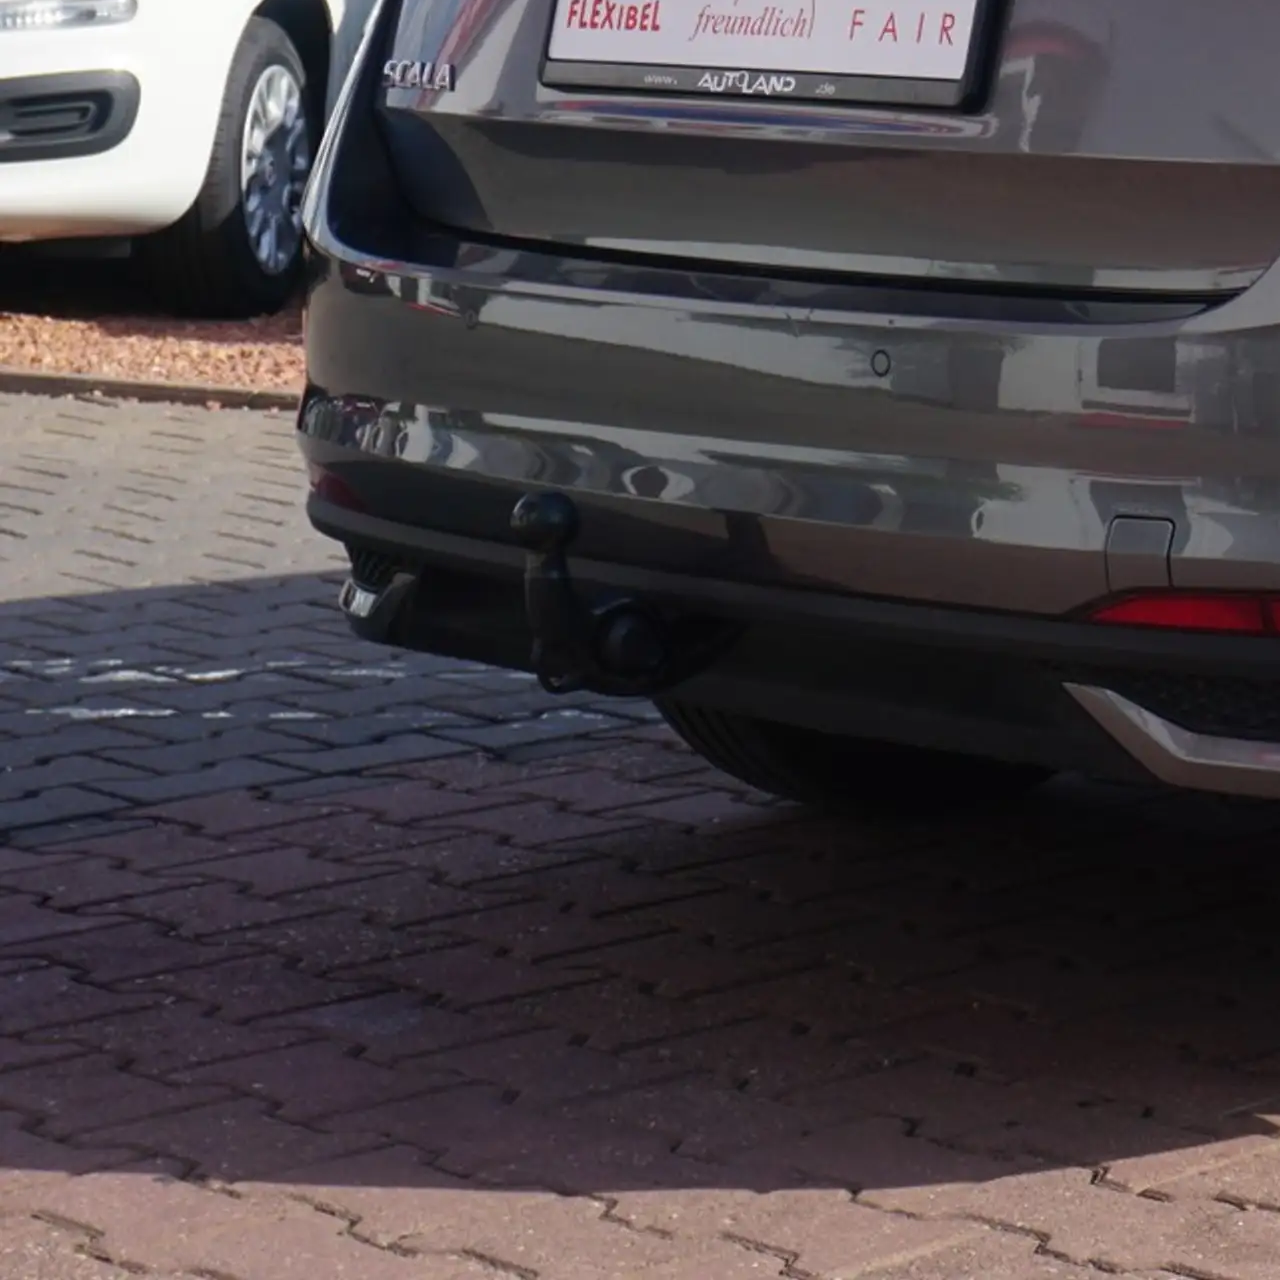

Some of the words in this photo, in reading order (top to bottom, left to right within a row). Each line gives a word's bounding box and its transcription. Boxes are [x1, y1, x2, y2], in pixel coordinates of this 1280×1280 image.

[688, 4, 807, 41] freundlich
[848, 9, 956, 47] FAIR
[383, 60, 454, 90] SCALA
[697, 70, 796, 95] AUTOLAND
